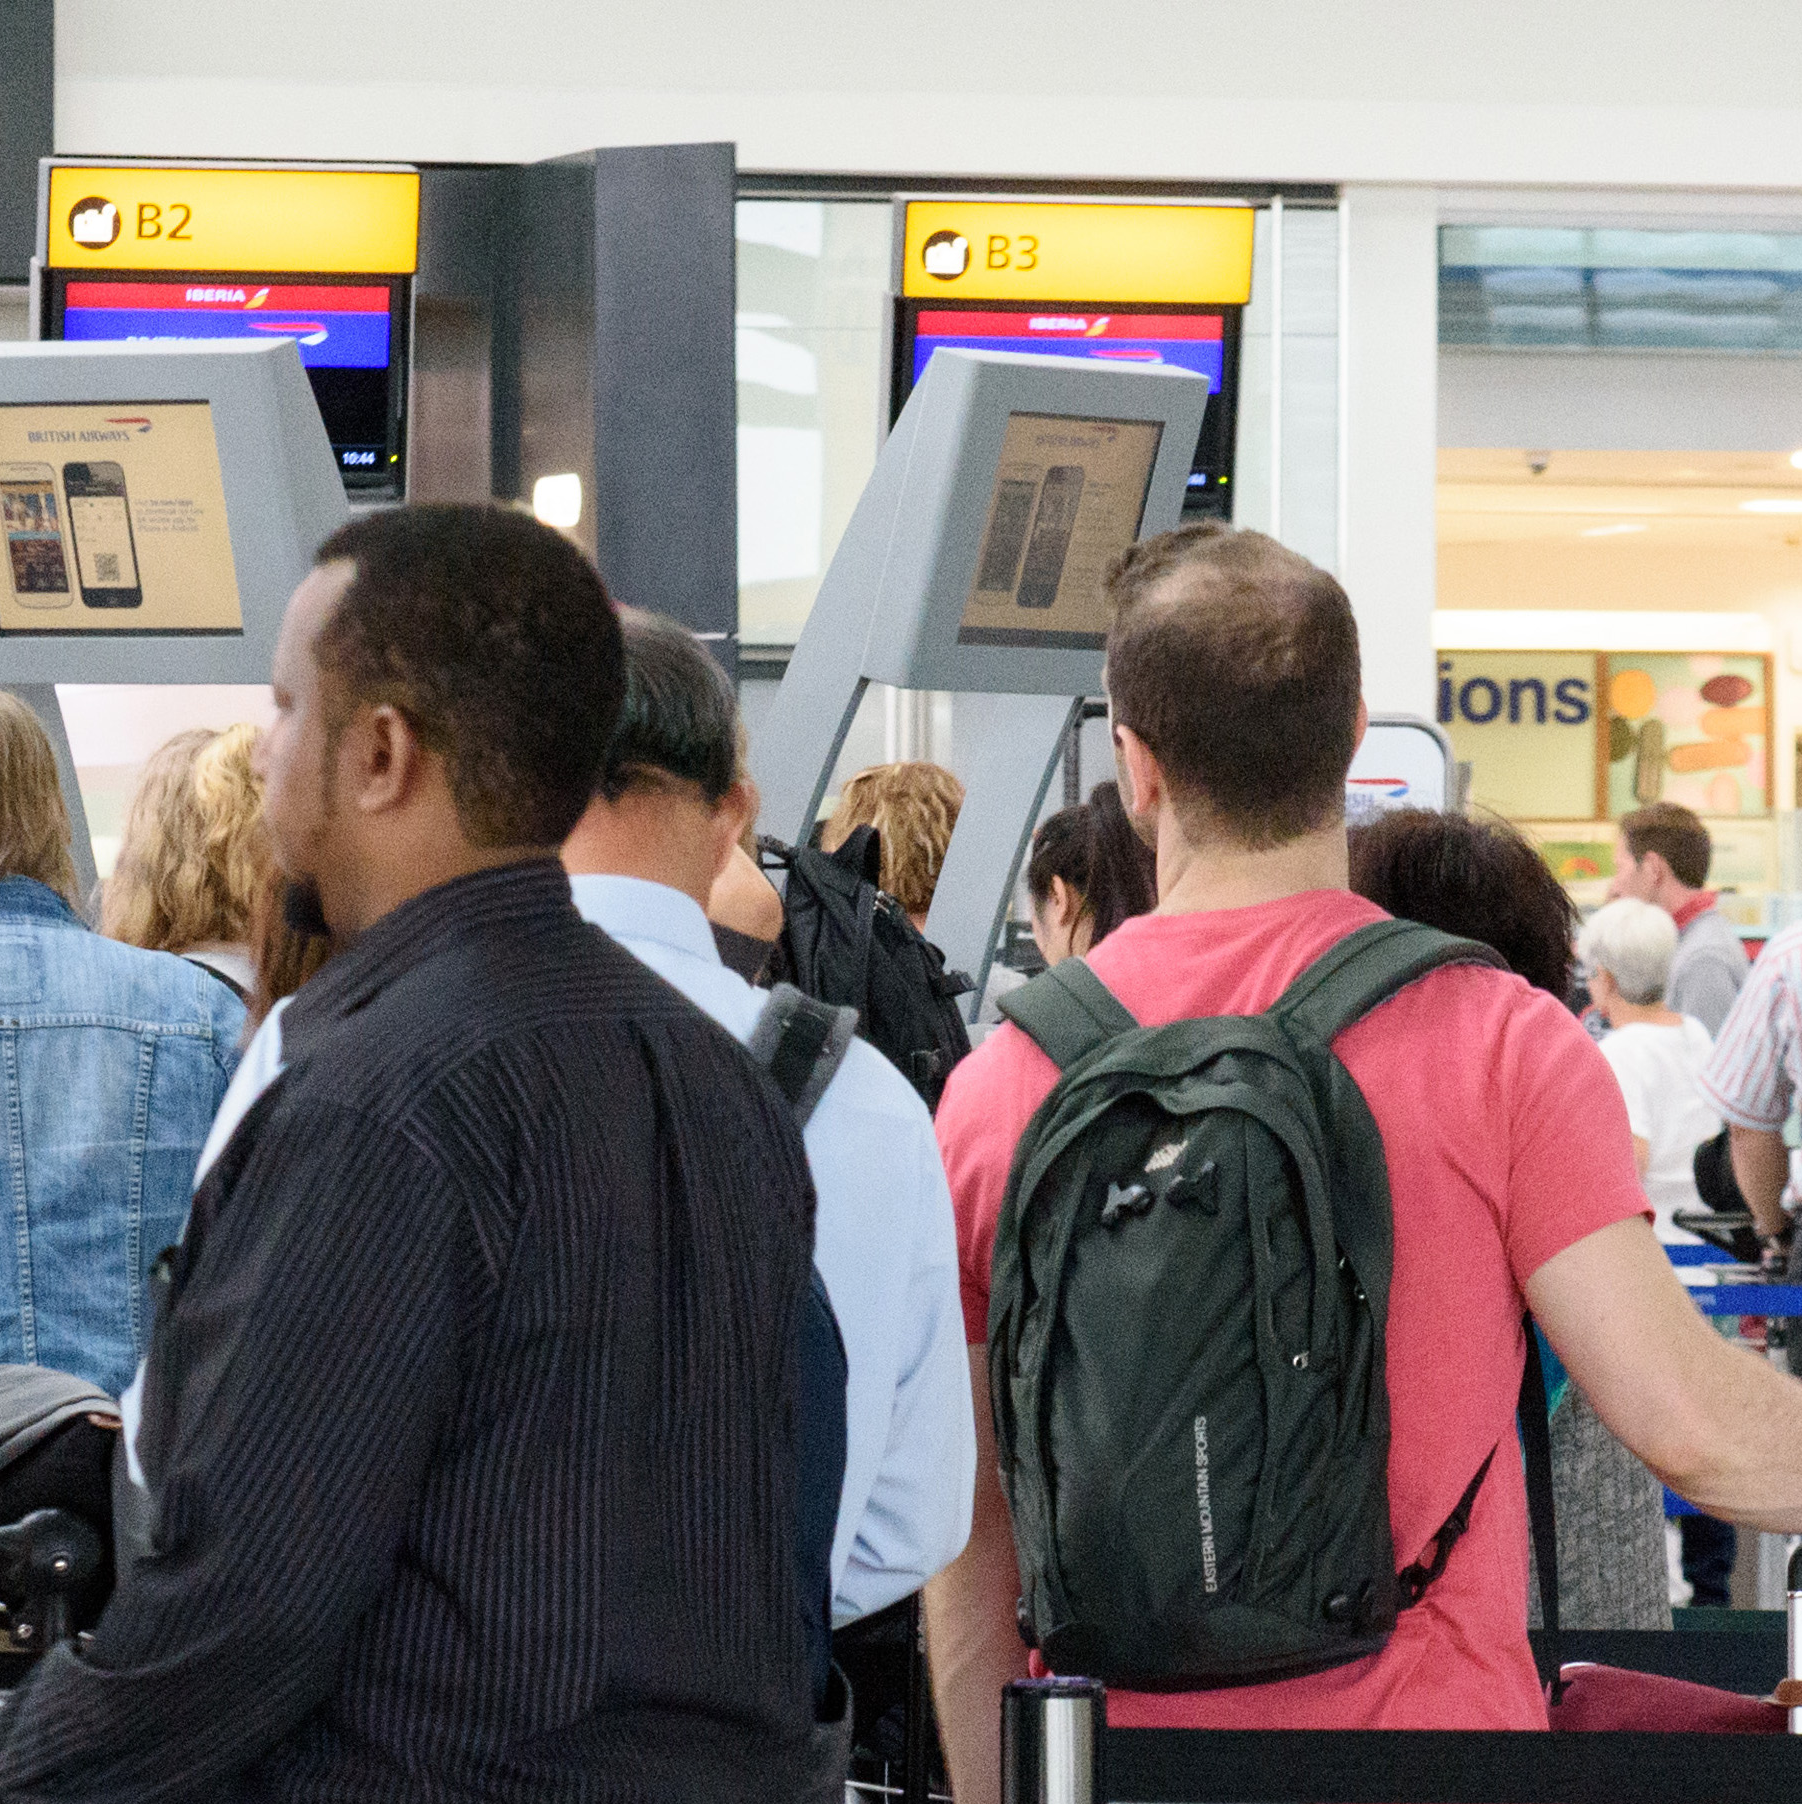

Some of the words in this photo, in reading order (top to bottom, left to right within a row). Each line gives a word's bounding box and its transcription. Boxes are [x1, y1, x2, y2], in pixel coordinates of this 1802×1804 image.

[135, 202, 194, 241] B2
[985, 233, 1040, 271] B3
[184, 287, 247, 303] IBERIA
[1438, 661, 1591, 726] ions
[1194, 1415, 1209, 1467] SPORTS
[1196, 1468, 1213, 1534] MOUNTAIN
[1201, 1534, 1218, 1592] EASTERN
